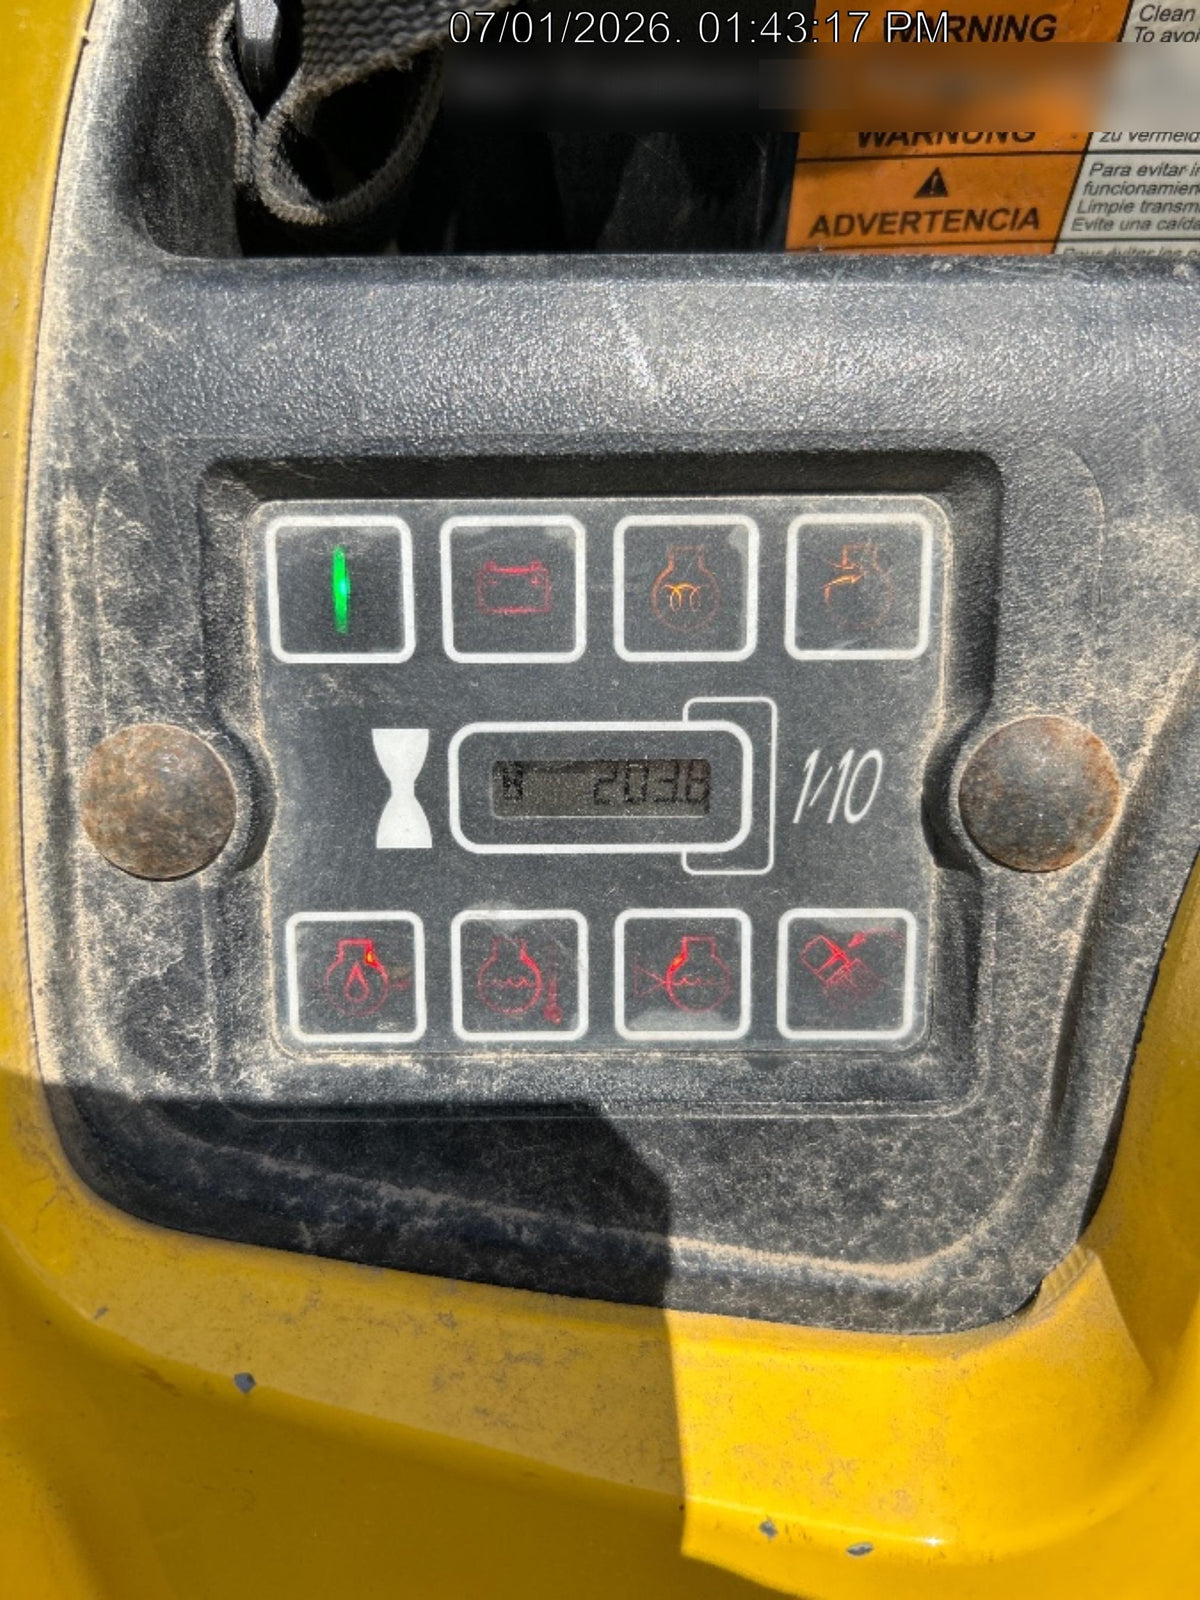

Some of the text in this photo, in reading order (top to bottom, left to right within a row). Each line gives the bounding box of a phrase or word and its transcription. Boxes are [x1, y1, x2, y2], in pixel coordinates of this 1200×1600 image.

[1139, 4, 1196, 22] Clean
[1134, 26, 1155, 42] To
[1089, 162, 1132, 177] Para
[1136, 161, 1187, 177] evitar
[1077, 199, 1136, 217] Limpie
[808, 207, 1040, 238] ADVERTENCIA
[1071, 217, 1115, 232] Evite
[1119, 220, 1152, 232] una
[792, 749, 883, 824] 1/10
